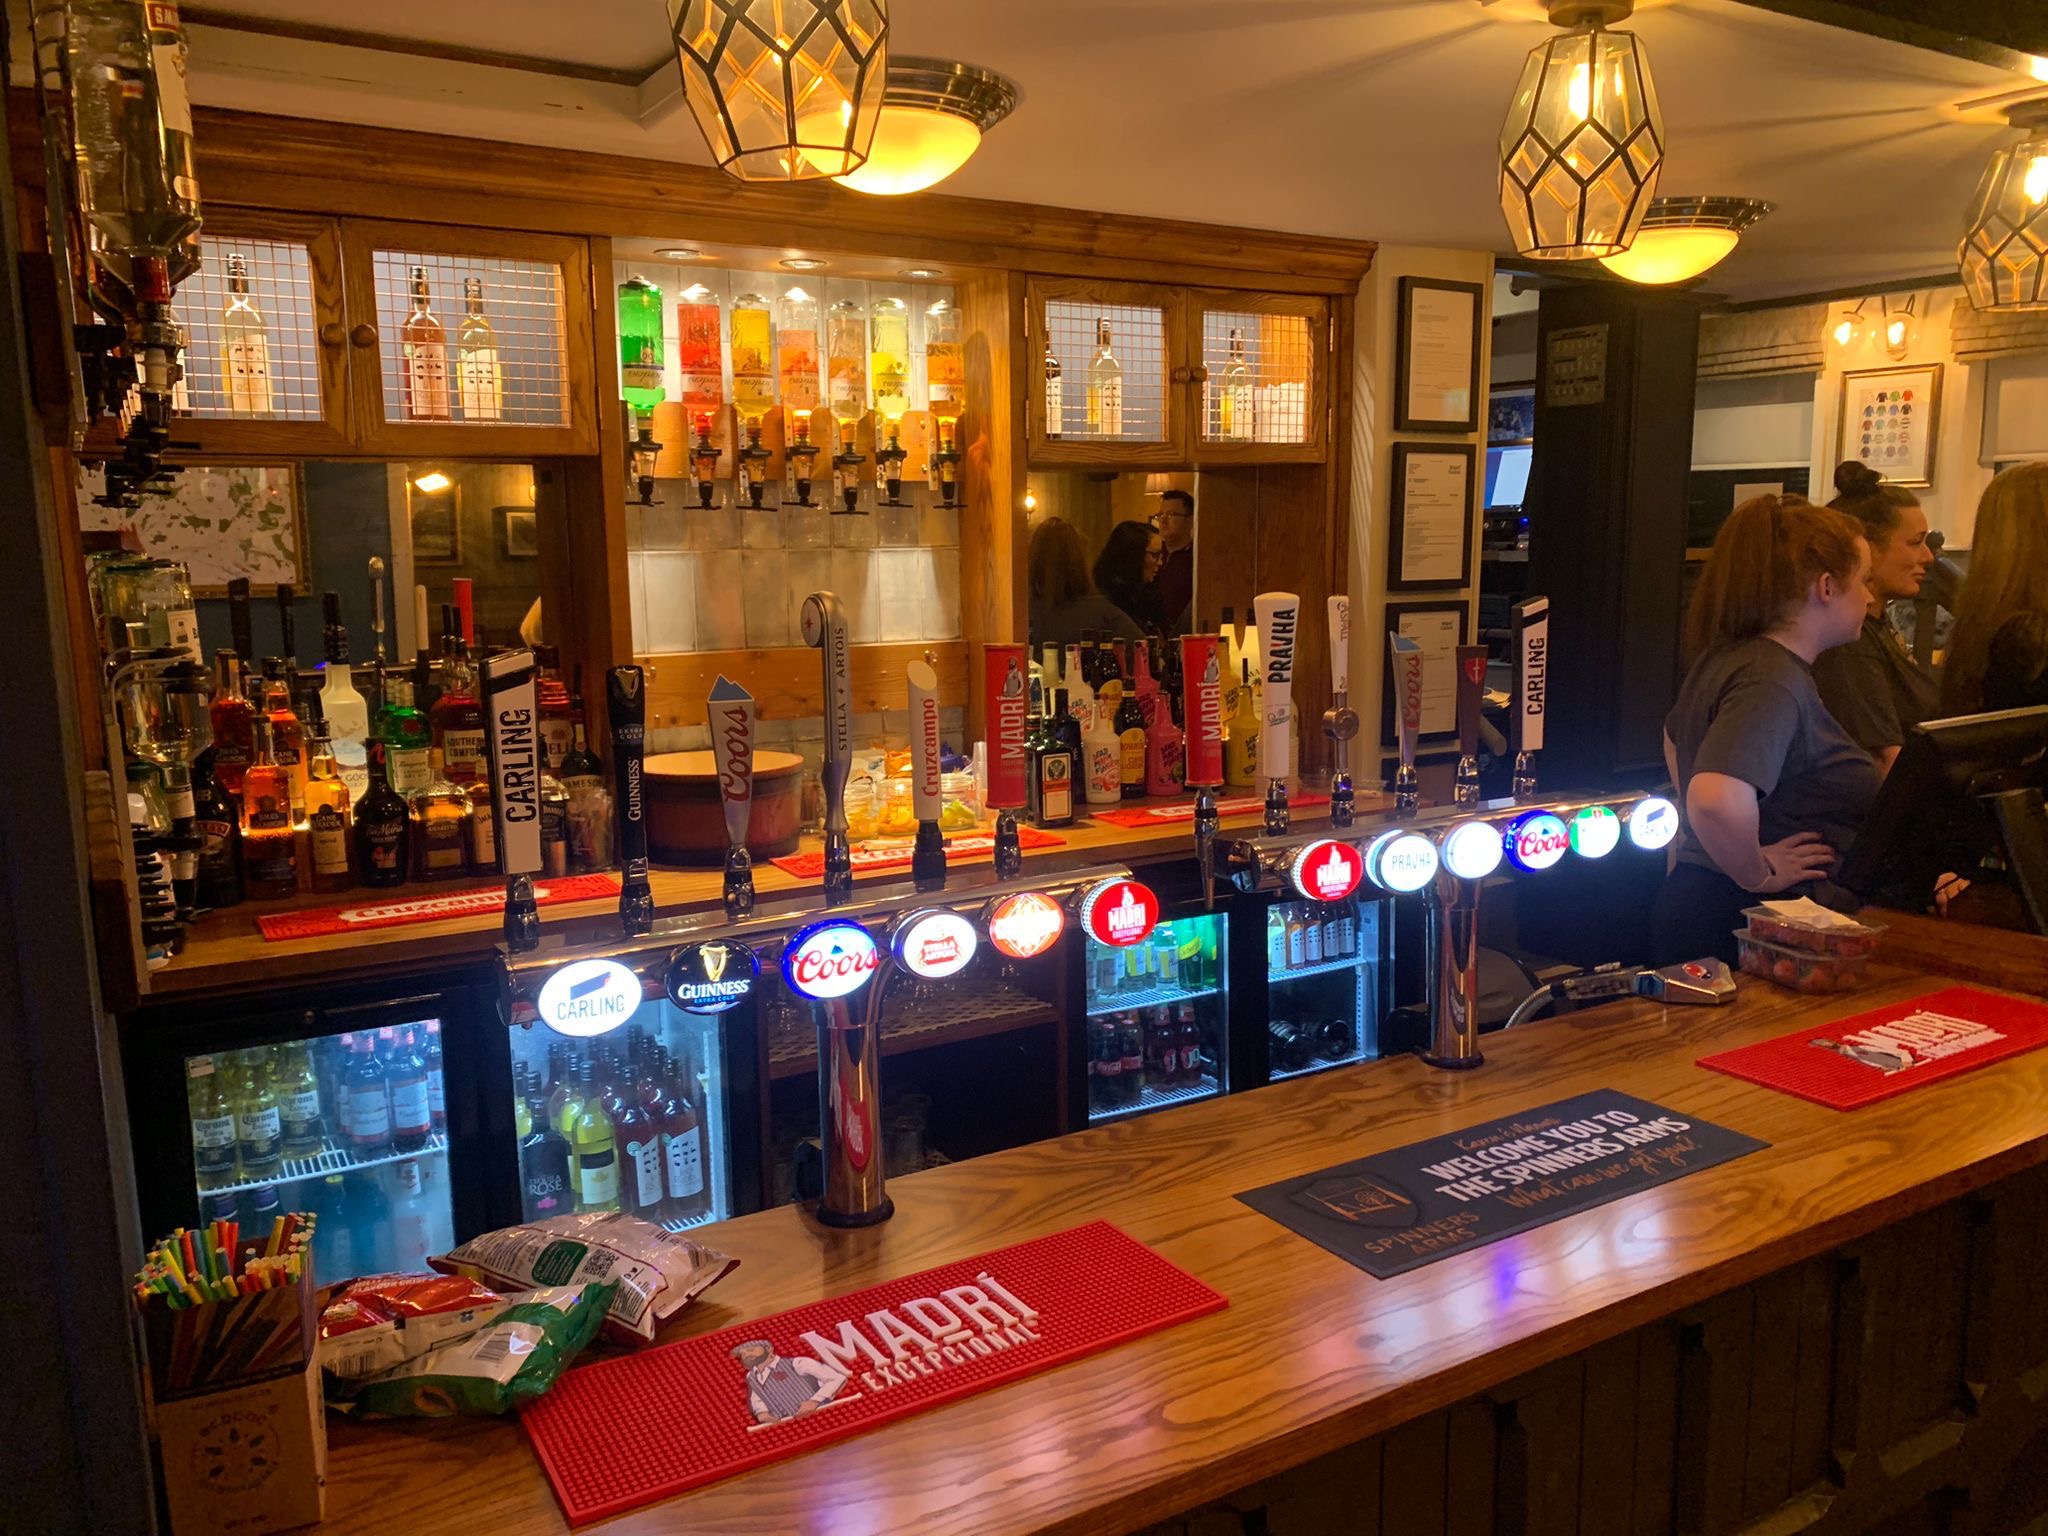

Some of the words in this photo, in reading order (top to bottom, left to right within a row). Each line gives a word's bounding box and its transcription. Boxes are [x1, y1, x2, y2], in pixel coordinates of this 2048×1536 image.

[834, 627, 845, 678] ARTOIS
[1527, 638, 1544, 715] CARLING
[1401, 654, 1420, 730] Coors
[720, 706, 751, 802] Coors
[839, 703, 847, 751] STELLA
[921, 698, 938, 797] Cruzcampo
[500, 709, 537, 823] CARLING
[628, 759, 642, 821] GUINNESS
[1518, 831, 1570, 857] Coors
[678, 979, 750, 1000] GUINNESS
[790, 946, 880, 984] Coors
[556, 994, 625, 1021] CARLING
[717, 994, 736, 1002] COLD
[1421, 1133, 1554, 1181] WELCOME
[1543, 1118, 1607, 1144] YOU
[1592, 1109, 1640, 1127] TO
[1435, 1172, 1506, 1202] THE
[1492, 1136, 1625, 1185] SPINNERS
[1611, 1116, 1691, 1148] ARMS
[1496, 1178, 1562, 1209] What
[1562, 1170, 1602, 1191] can
[1601, 1161, 1631, 1180] we
[1628, 1147, 1662, 1176] get
[1364, 1211, 1480, 1255] SPINNERS
[1410, 1227, 1477, 1256] ARMS
[799, 1271, 1039, 1378] MADRÍ
[861, 1323, 1041, 1392] EXCEPCIONAL
